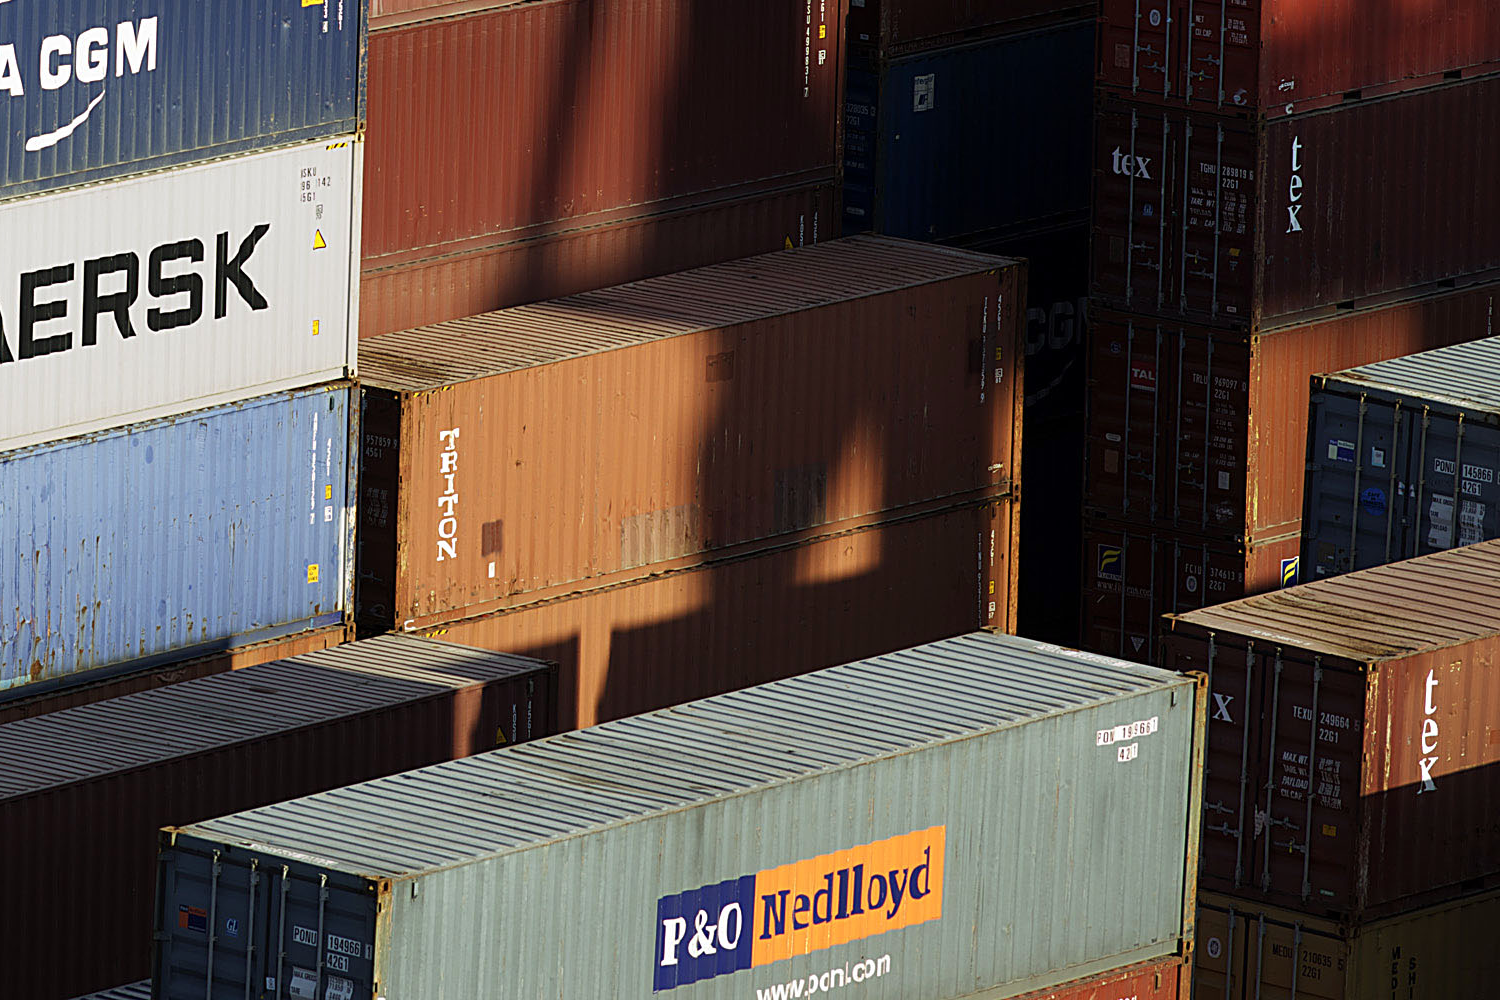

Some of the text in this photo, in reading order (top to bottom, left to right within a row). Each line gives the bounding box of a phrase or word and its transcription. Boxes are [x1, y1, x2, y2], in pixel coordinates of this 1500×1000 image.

[39, 16, 159, 91] CGM
[1111, 145, 1154, 180] tex
[1199, 162, 1216, 174] TGHU
[1222, 177, 1239, 190] 22G1
[1285, 135, 1303, 235] tex
[1132, 367, 1156, 380] TAL
[1192, 372, 1238, 391] TRLU 969097
[1214, 388, 1231, 400] 22G1
[365, 447, 382, 460] 45G1
[1435, 459, 1492, 483] PONU 145866
[438, 427, 460, 562] TRITON
[1462, 481, 1481, 496] 42G1
[1292, 704, 1350, 731] TEXU 249664
[1319, 728, 1339, 744] 22G1
[1416, 669, 1438, 795] tex
[659, 846, 931, 967] P&O Nedlloyd
[294, 927, 317, 945] PONU
[329, 936, 360, 955] 194966
[328, 954, 348, 970] 42G1
[1272, 942, 1293, 958] MEDU
[1303, 950, 1332, 969] 210635
[1302, 964, 1321, 980] 22G1
